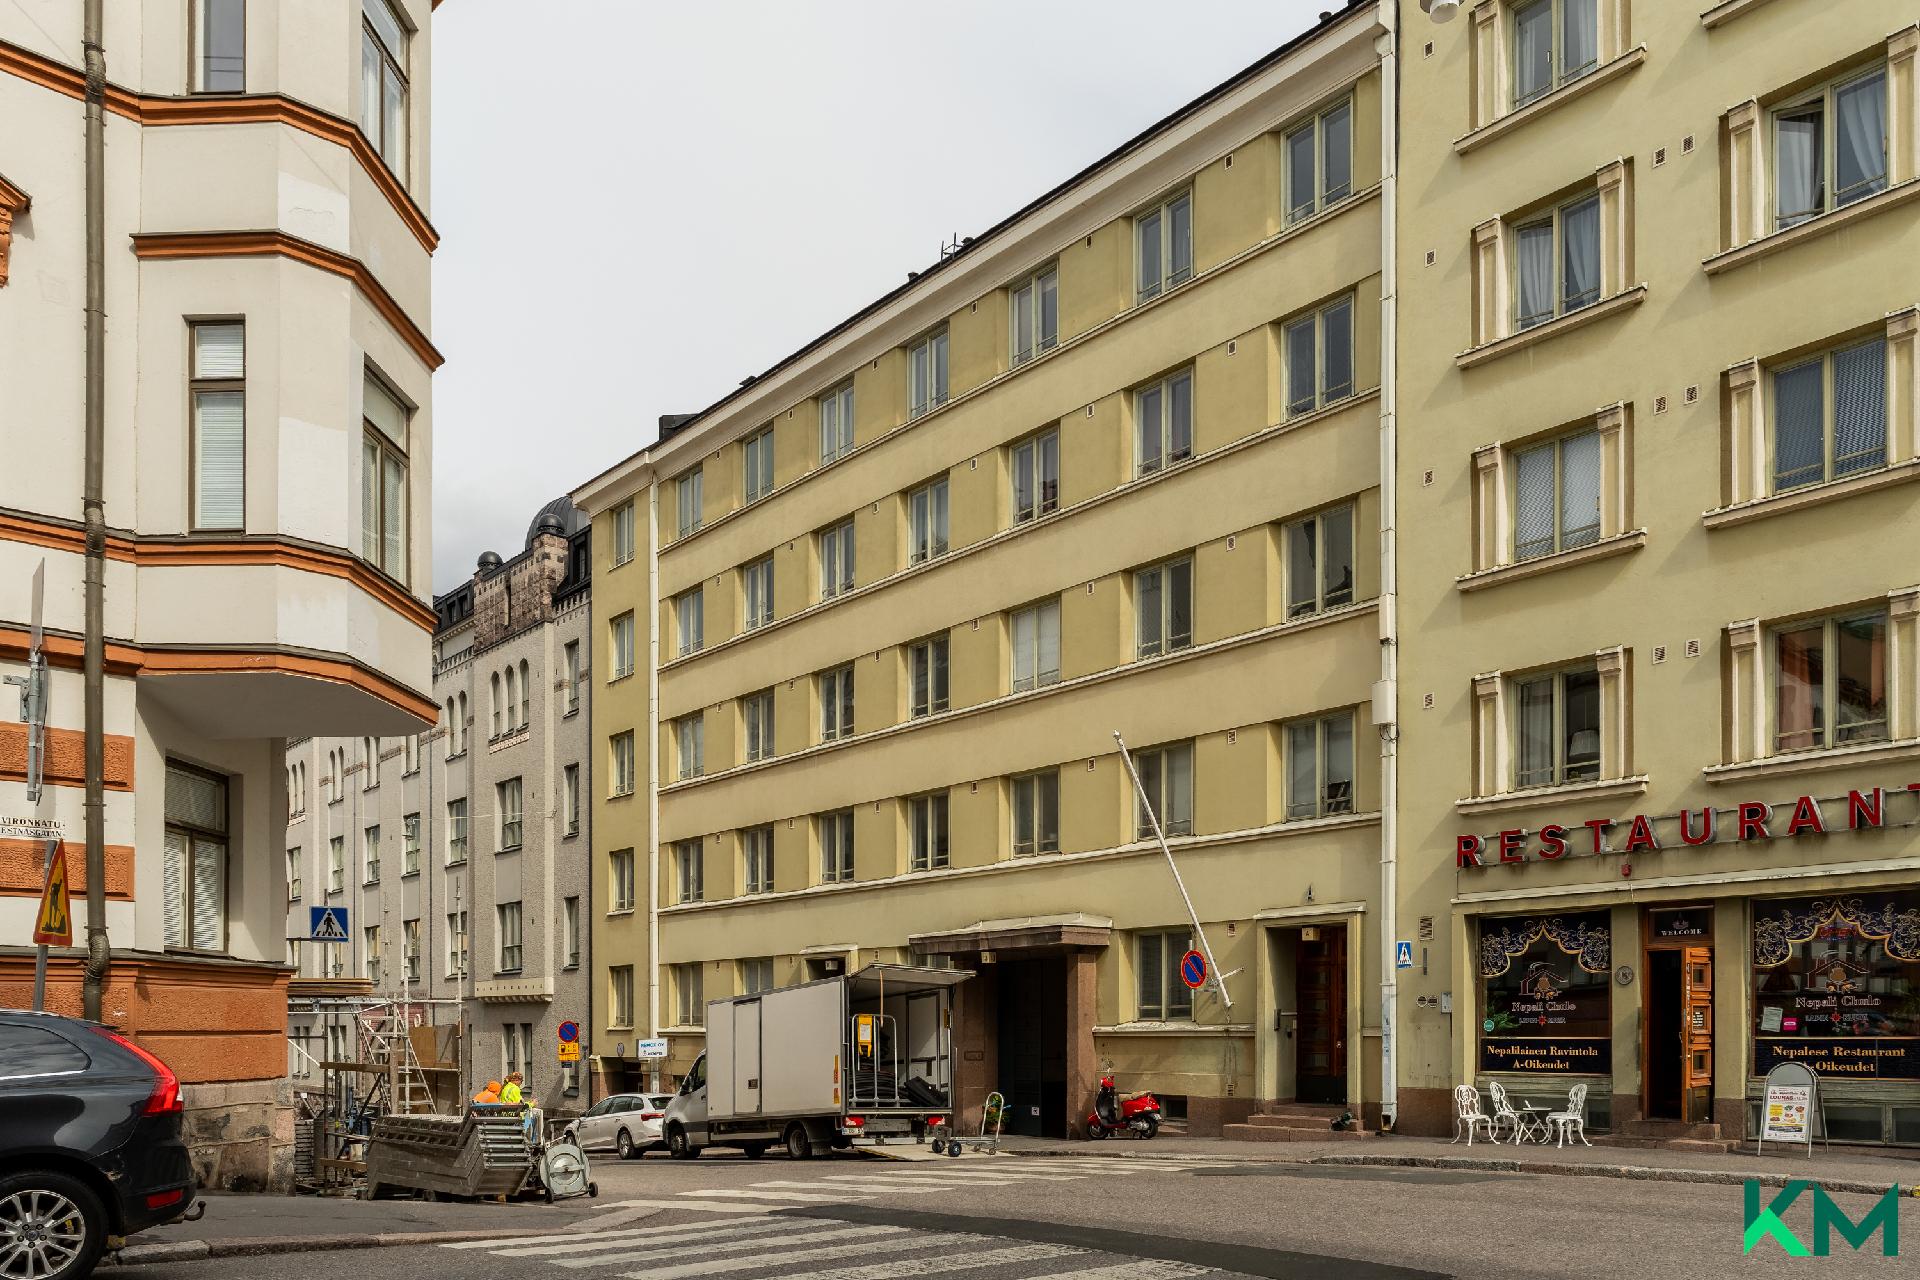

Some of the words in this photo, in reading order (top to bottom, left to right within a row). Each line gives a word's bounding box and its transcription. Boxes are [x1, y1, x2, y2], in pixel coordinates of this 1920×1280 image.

[2, 816, 61, 828] VIRONKATU
[1660, 928, 1702, 937] WELCOME
[1512, 1002, 1543, 1013] Nepali
[1546, 1001, 1577, 1011] Chulo
[1796, 996, 1837, 1009] Nepali
[1841, 995, 1881, 1007] Chulo
[1487, 1045, 1547, 1057] Nepalilainen
[1550, 1046, 1598, 1056] Ravintola
[1773, 1046, 1829, 1058] Nepalese
[1833, 1046, 1906, 1057] Restaurant
[1803, 1061, 1876, 1072] -Oikeudet
